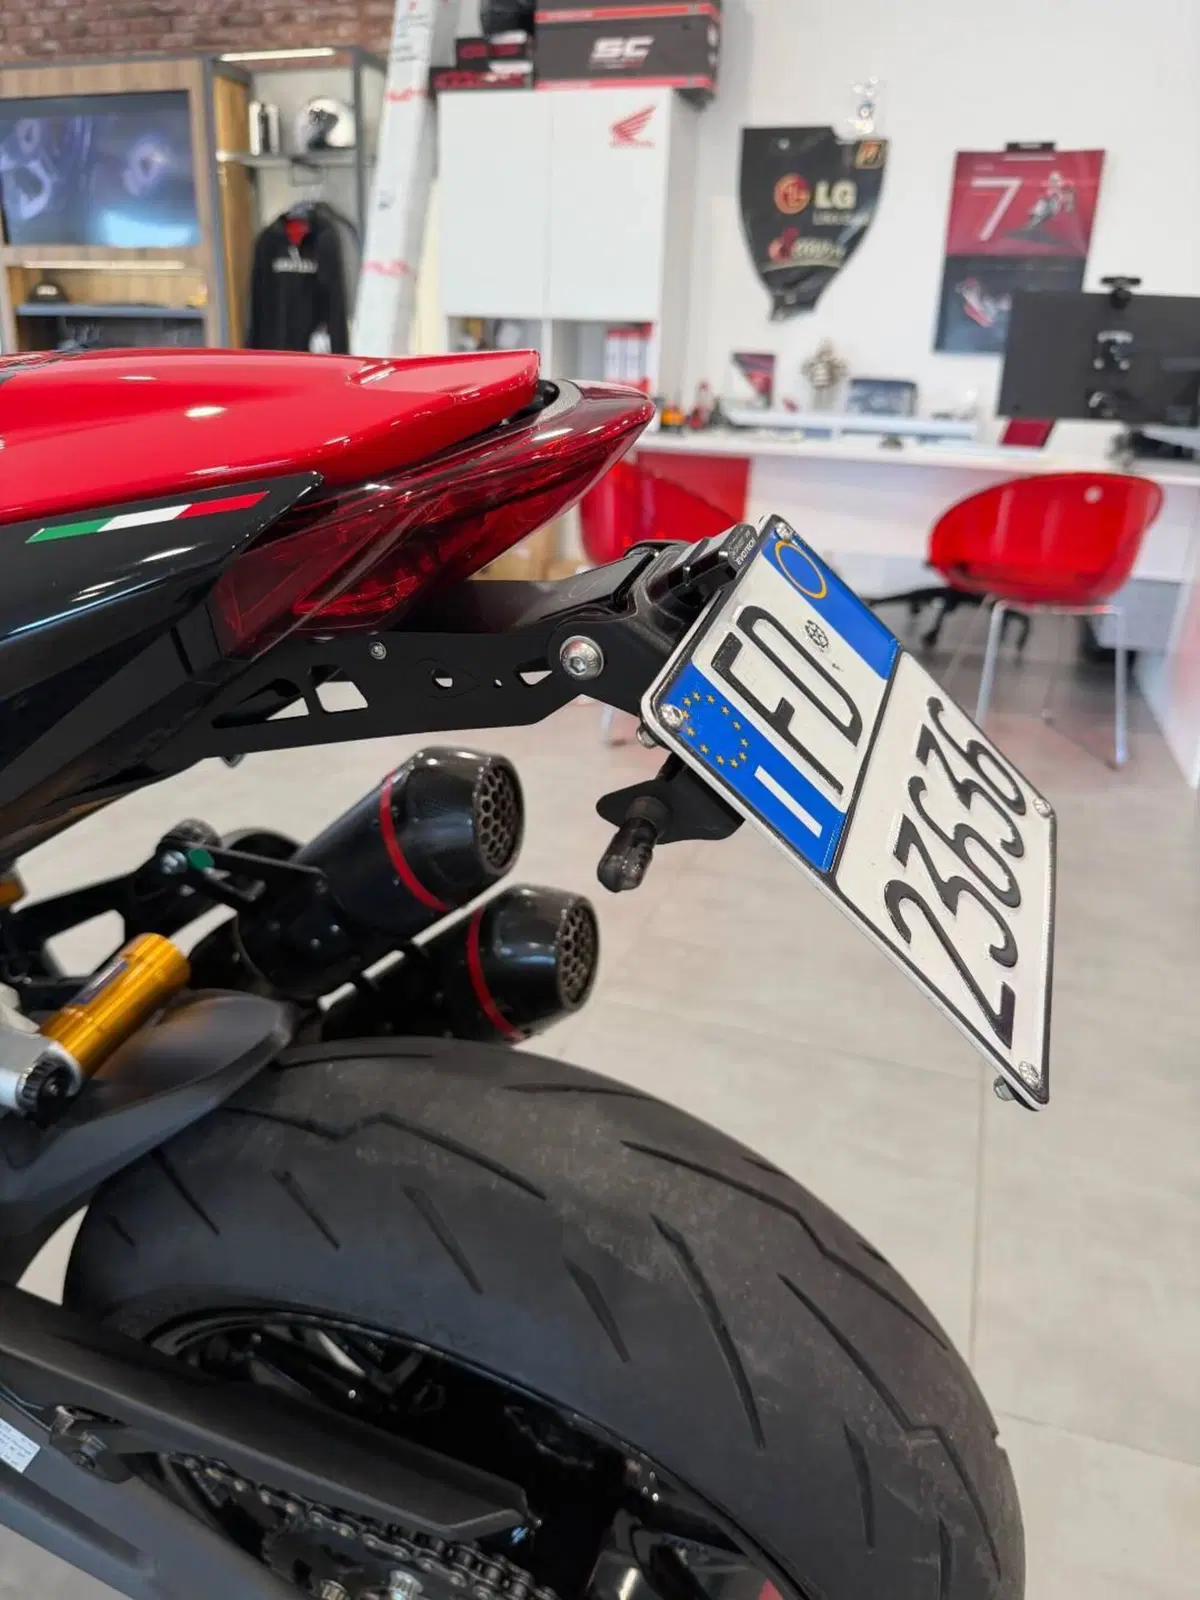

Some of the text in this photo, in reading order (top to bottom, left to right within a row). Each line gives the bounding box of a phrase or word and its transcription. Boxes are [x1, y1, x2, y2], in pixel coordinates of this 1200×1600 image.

[591, 36, 655, 58] SC
[814, 180, 858, 210] LG
[971, 176, 1022, 241] 7
[711, 605, 863, 796] FD
[884, 696, 1027, 1050] 23636
